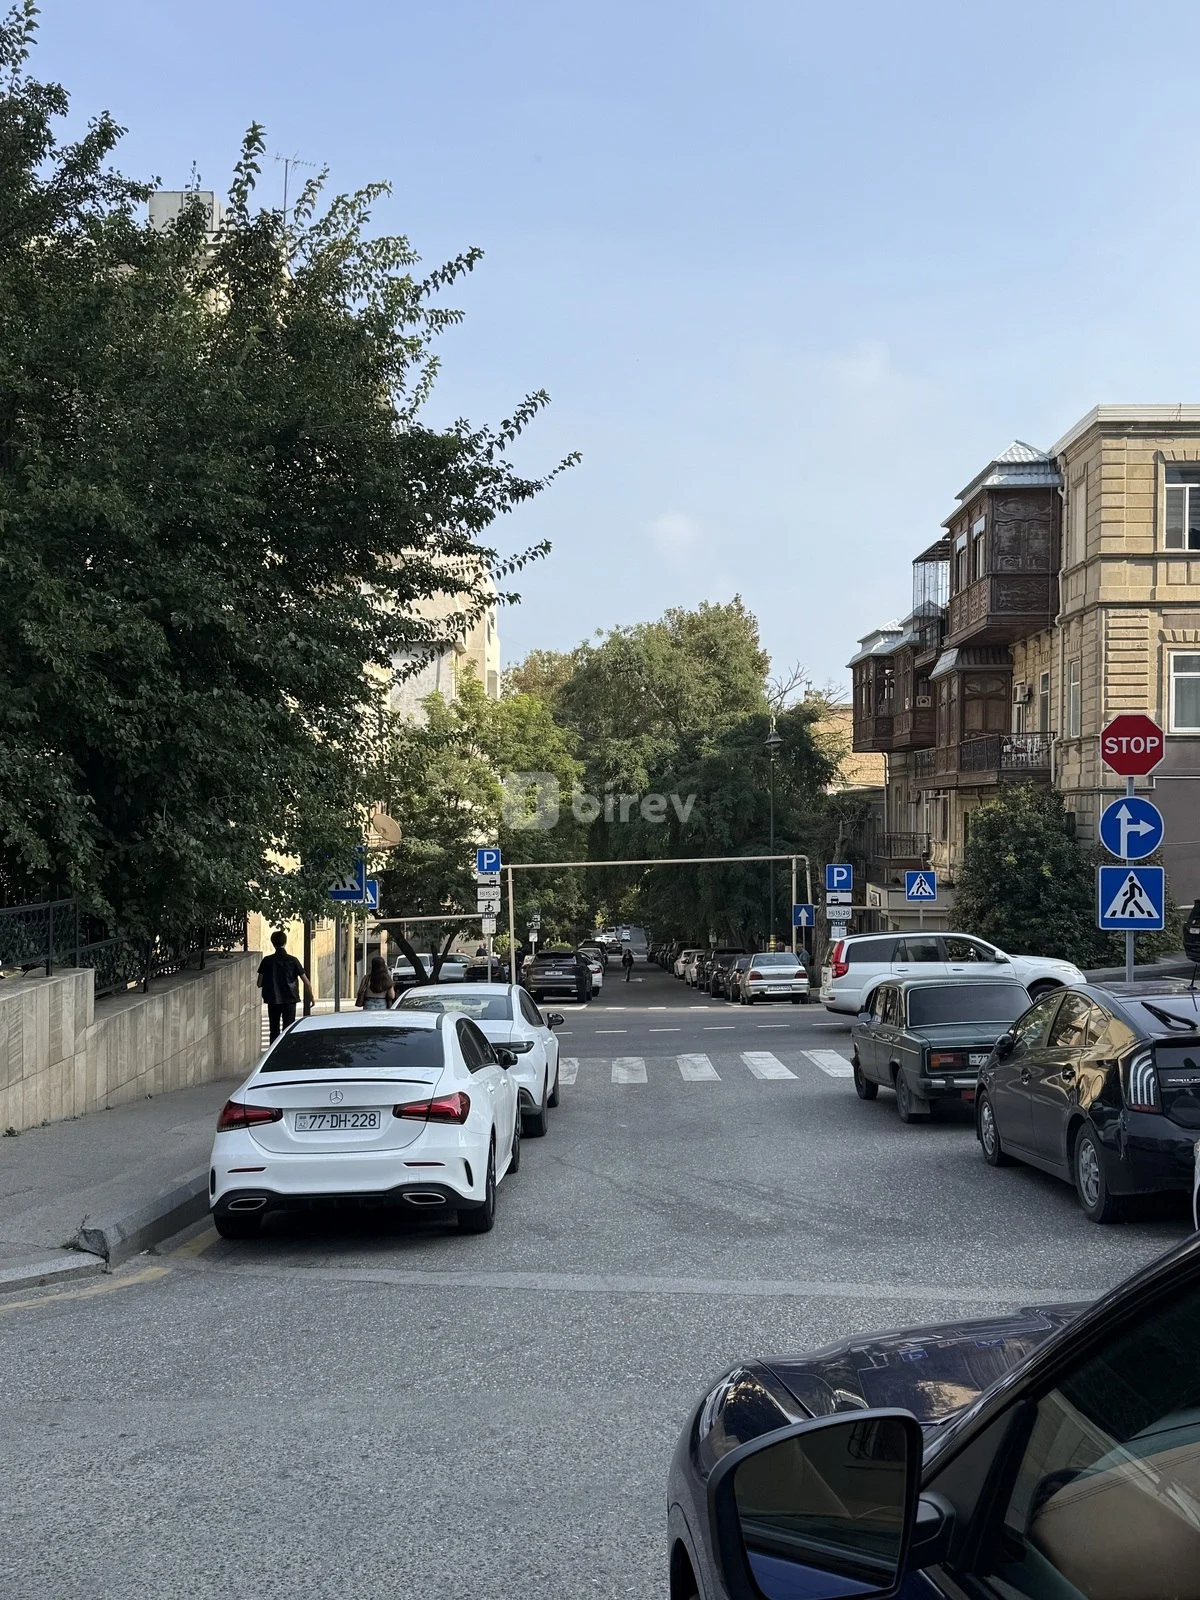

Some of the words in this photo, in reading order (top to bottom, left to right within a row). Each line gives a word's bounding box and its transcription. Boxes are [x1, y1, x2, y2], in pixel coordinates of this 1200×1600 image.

[1104, 736, 1160, 755] STOP
[484, 851, 496, 869] P
[833, 867, 847, 887] P
[309, 1113, 377, 1129] 77-DH-228
